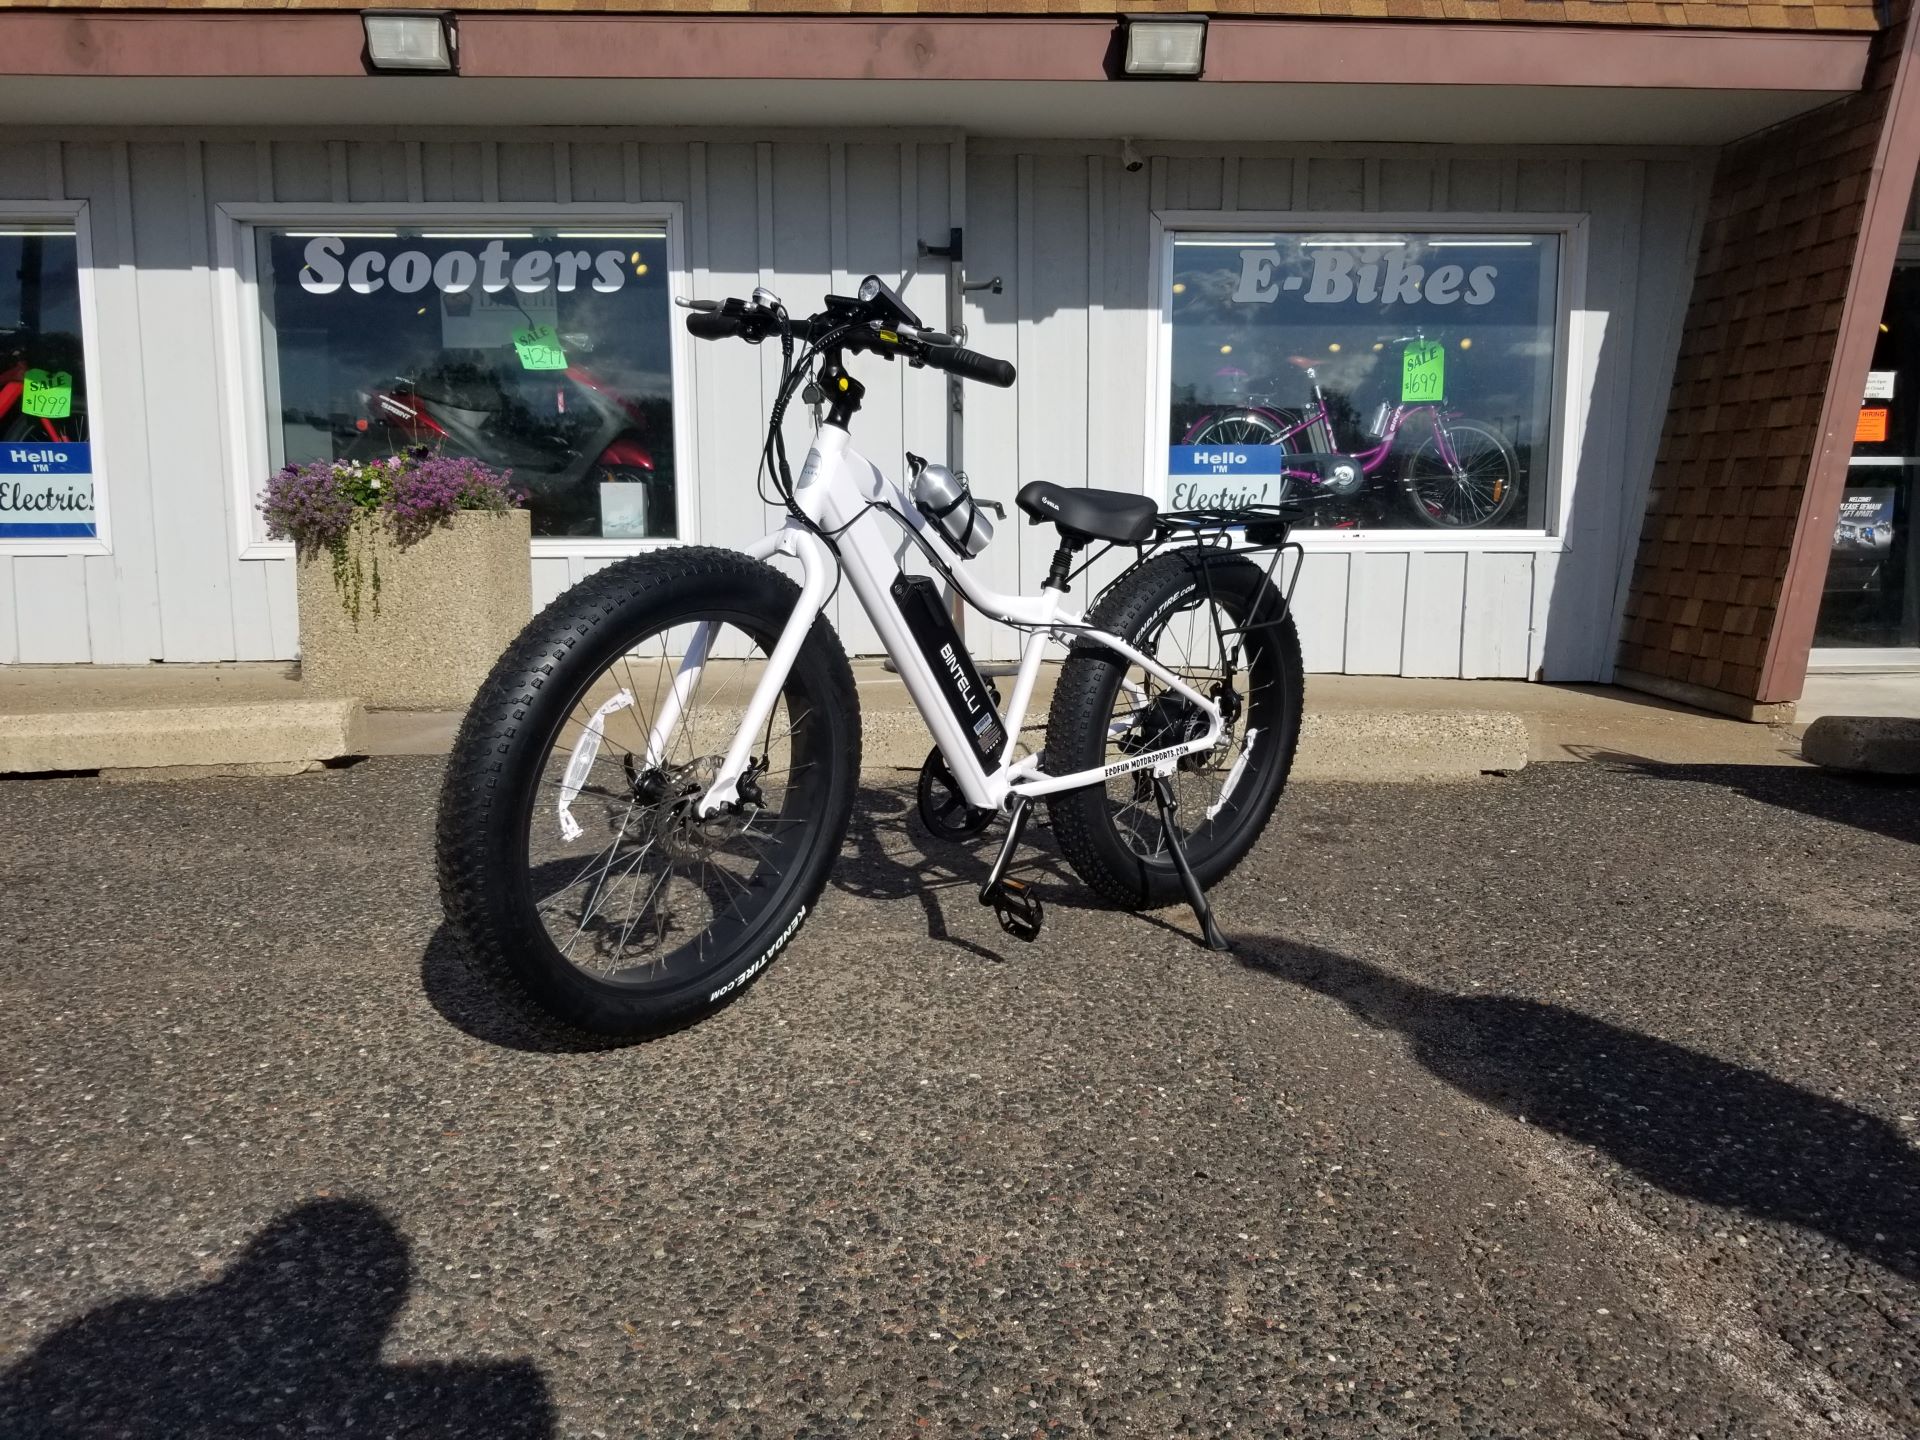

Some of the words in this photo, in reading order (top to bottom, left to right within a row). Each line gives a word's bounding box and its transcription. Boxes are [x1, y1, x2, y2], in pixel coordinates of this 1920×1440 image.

[299, 237, 626, 294] Scooters
[1232, 250, 1498, 305] E-Bikes
[519, 326, 550, 346] SALE
[1407, 346, 1439, 372] SALE
[30, 375, 66, 392] SALE
[1405, 371, 1438, 394] $1699
[26, 394, 68, 414] $1999
[10, 450, 69, 463] Hello
[1193, 452, 1248, 464] Hello
[32, 464, 50, 473] I'M
[1212, 465, 1229, 473] I'M
[940, 643, 981, 714] BINTELLI
[1104, 764, 1130, 777] ECOFUN
[710, 904, 807, 1002] KENDATIRE.COM
